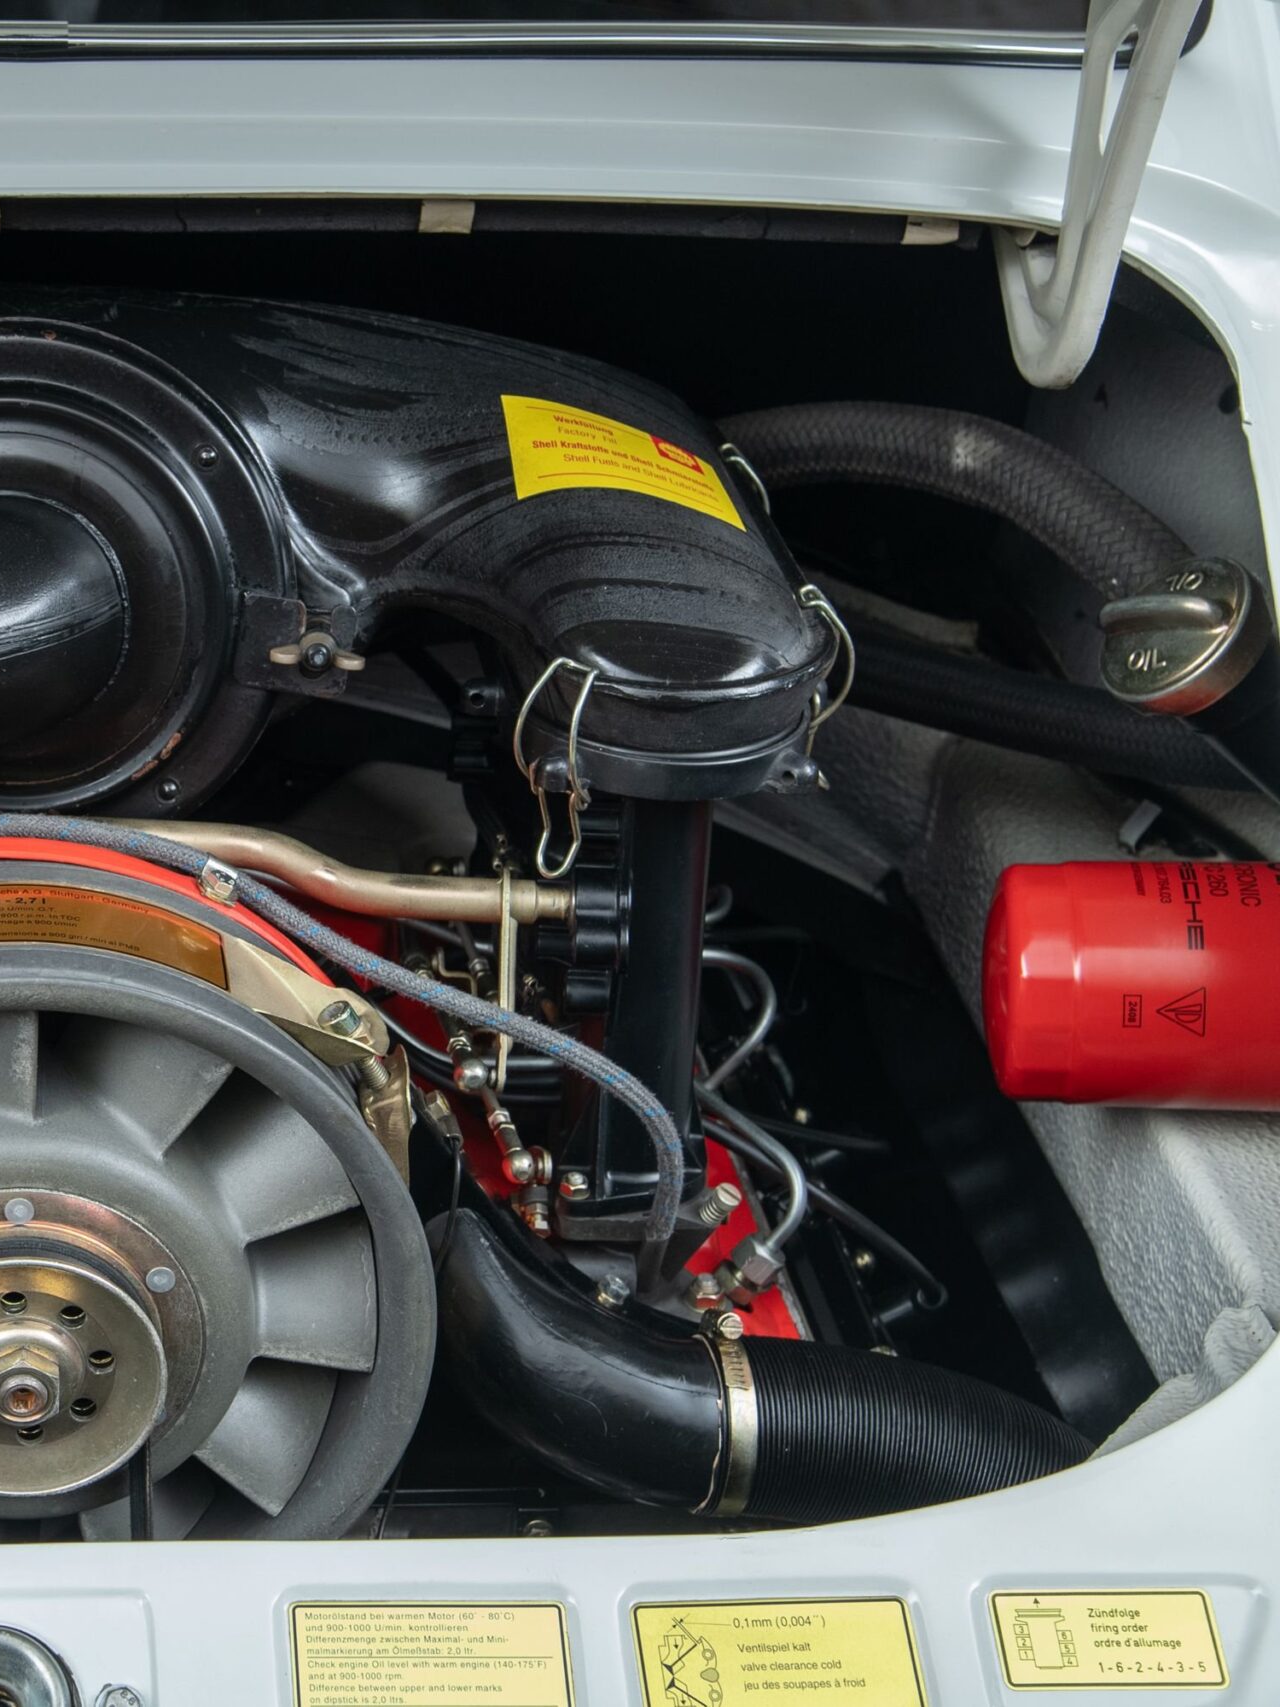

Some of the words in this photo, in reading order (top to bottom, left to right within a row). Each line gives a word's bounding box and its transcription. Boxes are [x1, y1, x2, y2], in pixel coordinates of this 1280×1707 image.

[558, 426, 597, 441] Factory
[532, 440, 558, 449] Shell
[563, 453, 590, 463] Shell
[1127, 648, 1167, 672] OIL
[1206, 874, 1230, 898] 260
[49, 890, 94, 901] Stuttgart
[101, 897, 150, 914] Germany
[304, 1611, 367, 1621] Motorölstand
[369, 1611, 385, 1621] bei
[388, 1613, 426, 1621] warmen
[428, 1611, 456, 1620] Motor
[1086, 1607, 1140, 1620] Zündfolge
[305, 1623, 324, 1632] und
[326, 1623, 372, 1632] 900-1000
[408, 1623, 469, 1632] kontrollieren
[1018, 1625, 1024, 1634] 3
[1090, 1622, 1119, 1635] firing
[1121, 1622, 1148, 1633] order
[306, 1634, 377, 1646] Differenzmenge
[379, 1635, 421, 1644] zwischen
[423, 1634, 465, 1644] Maximal-
[467, 1634, 485, 1644] und
[486, 1634, 510, 1644] Mini-
[1061, 1631, 1067, 1640] 6
[737, 1642, 791, 1654] Ventilspiel
[793, 1641, 812, 1652] kalt
[1020, 1638, 1027, 1646] 2
[1093, 1637, 1123, 1648] ordre
[1125, 1636, 1182, 1649] d'allumage
[306, 1646, 373, 1657] malmarkierung
[376, 1648, 390, 1656] am
[446, 1647, 461, 1657] 2,0
[1024, 1650, 1029, 1659] 1
[1064, 1644, 1070, 1653] 5
[307, 1659, 336, 1669] Check
[338, 1660, 370, 1671] engine
[371, 1659, 385, 1669] Oil
[387, 1659, 411, 1669] level
[413, 1659, 430, 1669] with
[432, 1661, 457, 1669] warm
[459, 1660, 491, 1671] engine
[740, 1661, 768, 1672] valve
[770, 1660, 819, 1671] clearance
[821, 1658, 842, 1669] cold
[1067, 1657, 1073, 1665] 4
[308, 1671, 327, 1680] and
[328, 1672, 337, 1680] at
[339, 1671, 382, 1681] 900-1000
[309, 1683, 357, 1693] Difference
[358, 1683, 397, 1693] between
[399, 1685, 426, 1695] upper
[428, 1683, 446, 1693] and
[448, 1683, 473, 1693] lower
[475, 1683, 503, 1693] marks
[743, 1679, 760, 1693] jeu
[762, 1679, 781, 1690] des
[783, 1680, 832, 1692] soupapes
[834, 1677, 842, 1688] à
[843, 1677, 866, 1688] froid
[310, 1697, 322, 1705] on
[324, 1694, 360, 1707] dipstick
[361, 1695, 370, 1705] is
[372, 1695, 387, 1706] 2,0
